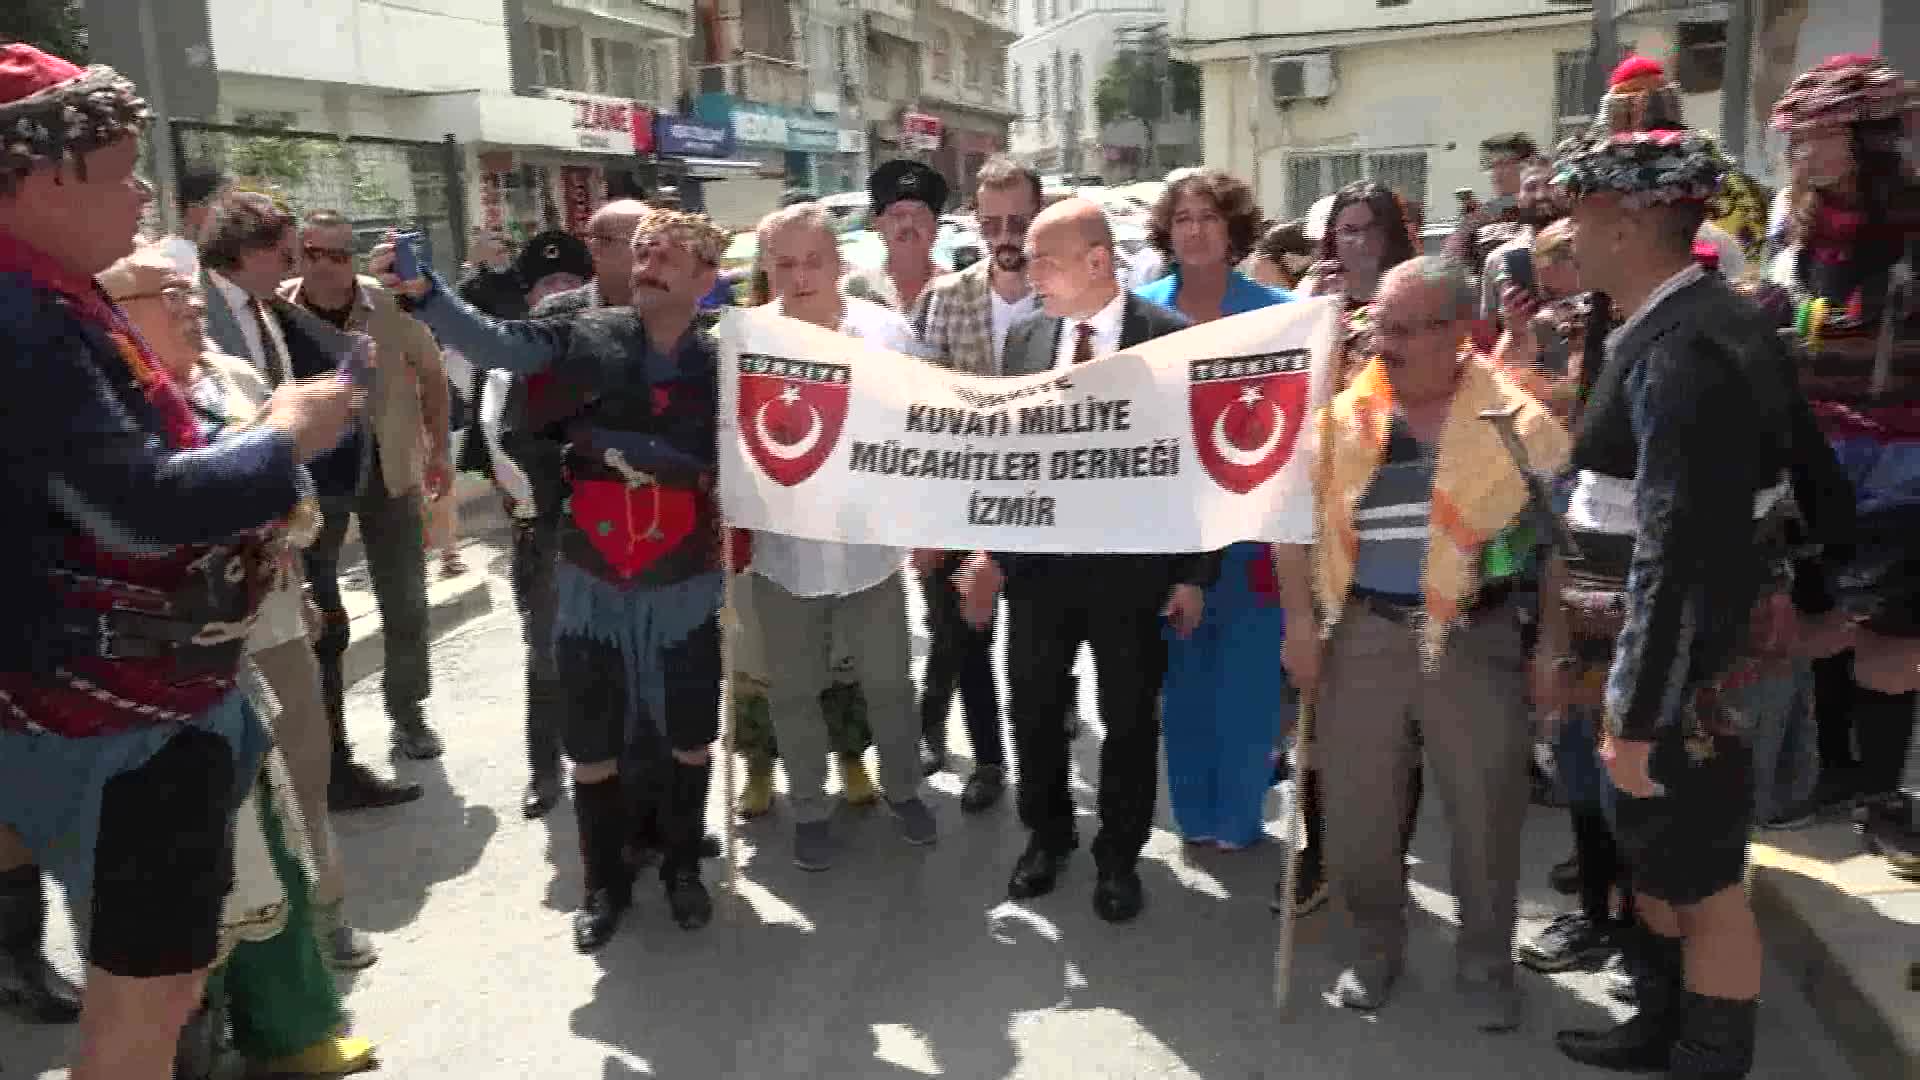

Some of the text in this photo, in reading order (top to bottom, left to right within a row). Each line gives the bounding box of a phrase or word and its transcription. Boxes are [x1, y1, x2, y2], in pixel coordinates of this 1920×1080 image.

[1019, 397, 1131, 435] MİLLİYE
[849, 438, 1181, 481] MÜCAHİTLER DERNEĞİ
[968, 489, 1055, 527] İZMİR
